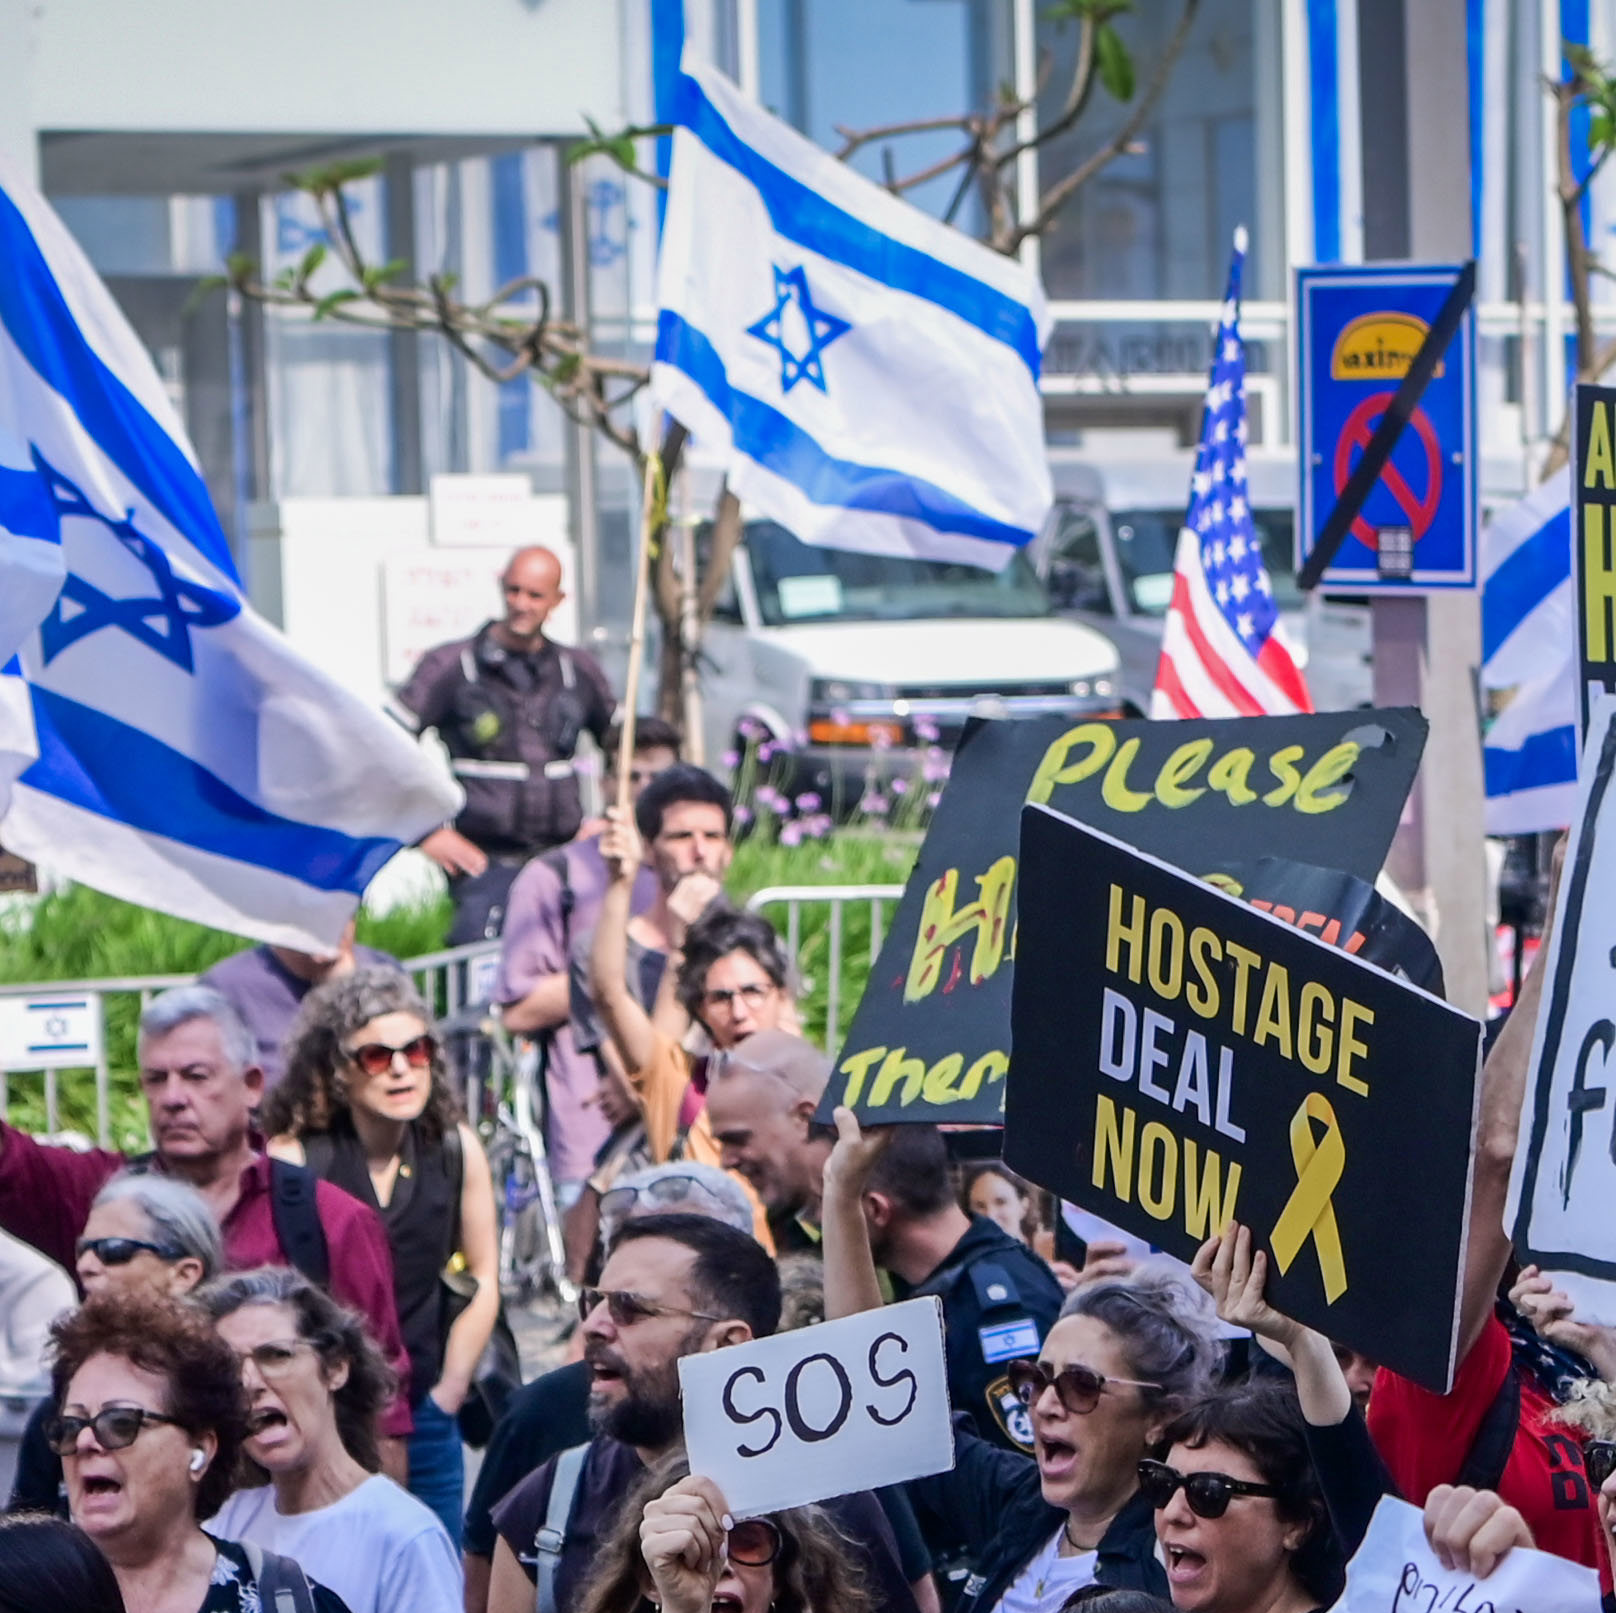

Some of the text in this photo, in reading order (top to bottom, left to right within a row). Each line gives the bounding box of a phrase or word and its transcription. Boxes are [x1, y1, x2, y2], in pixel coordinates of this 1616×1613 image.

[1099, 986, 1246, 1144] DEAL
[1106, 883, 1375, 1098] HOSTAGE
[1092, 1093, 1242, 1242] NOW
[722, 1332, 918, 1458] SOS
